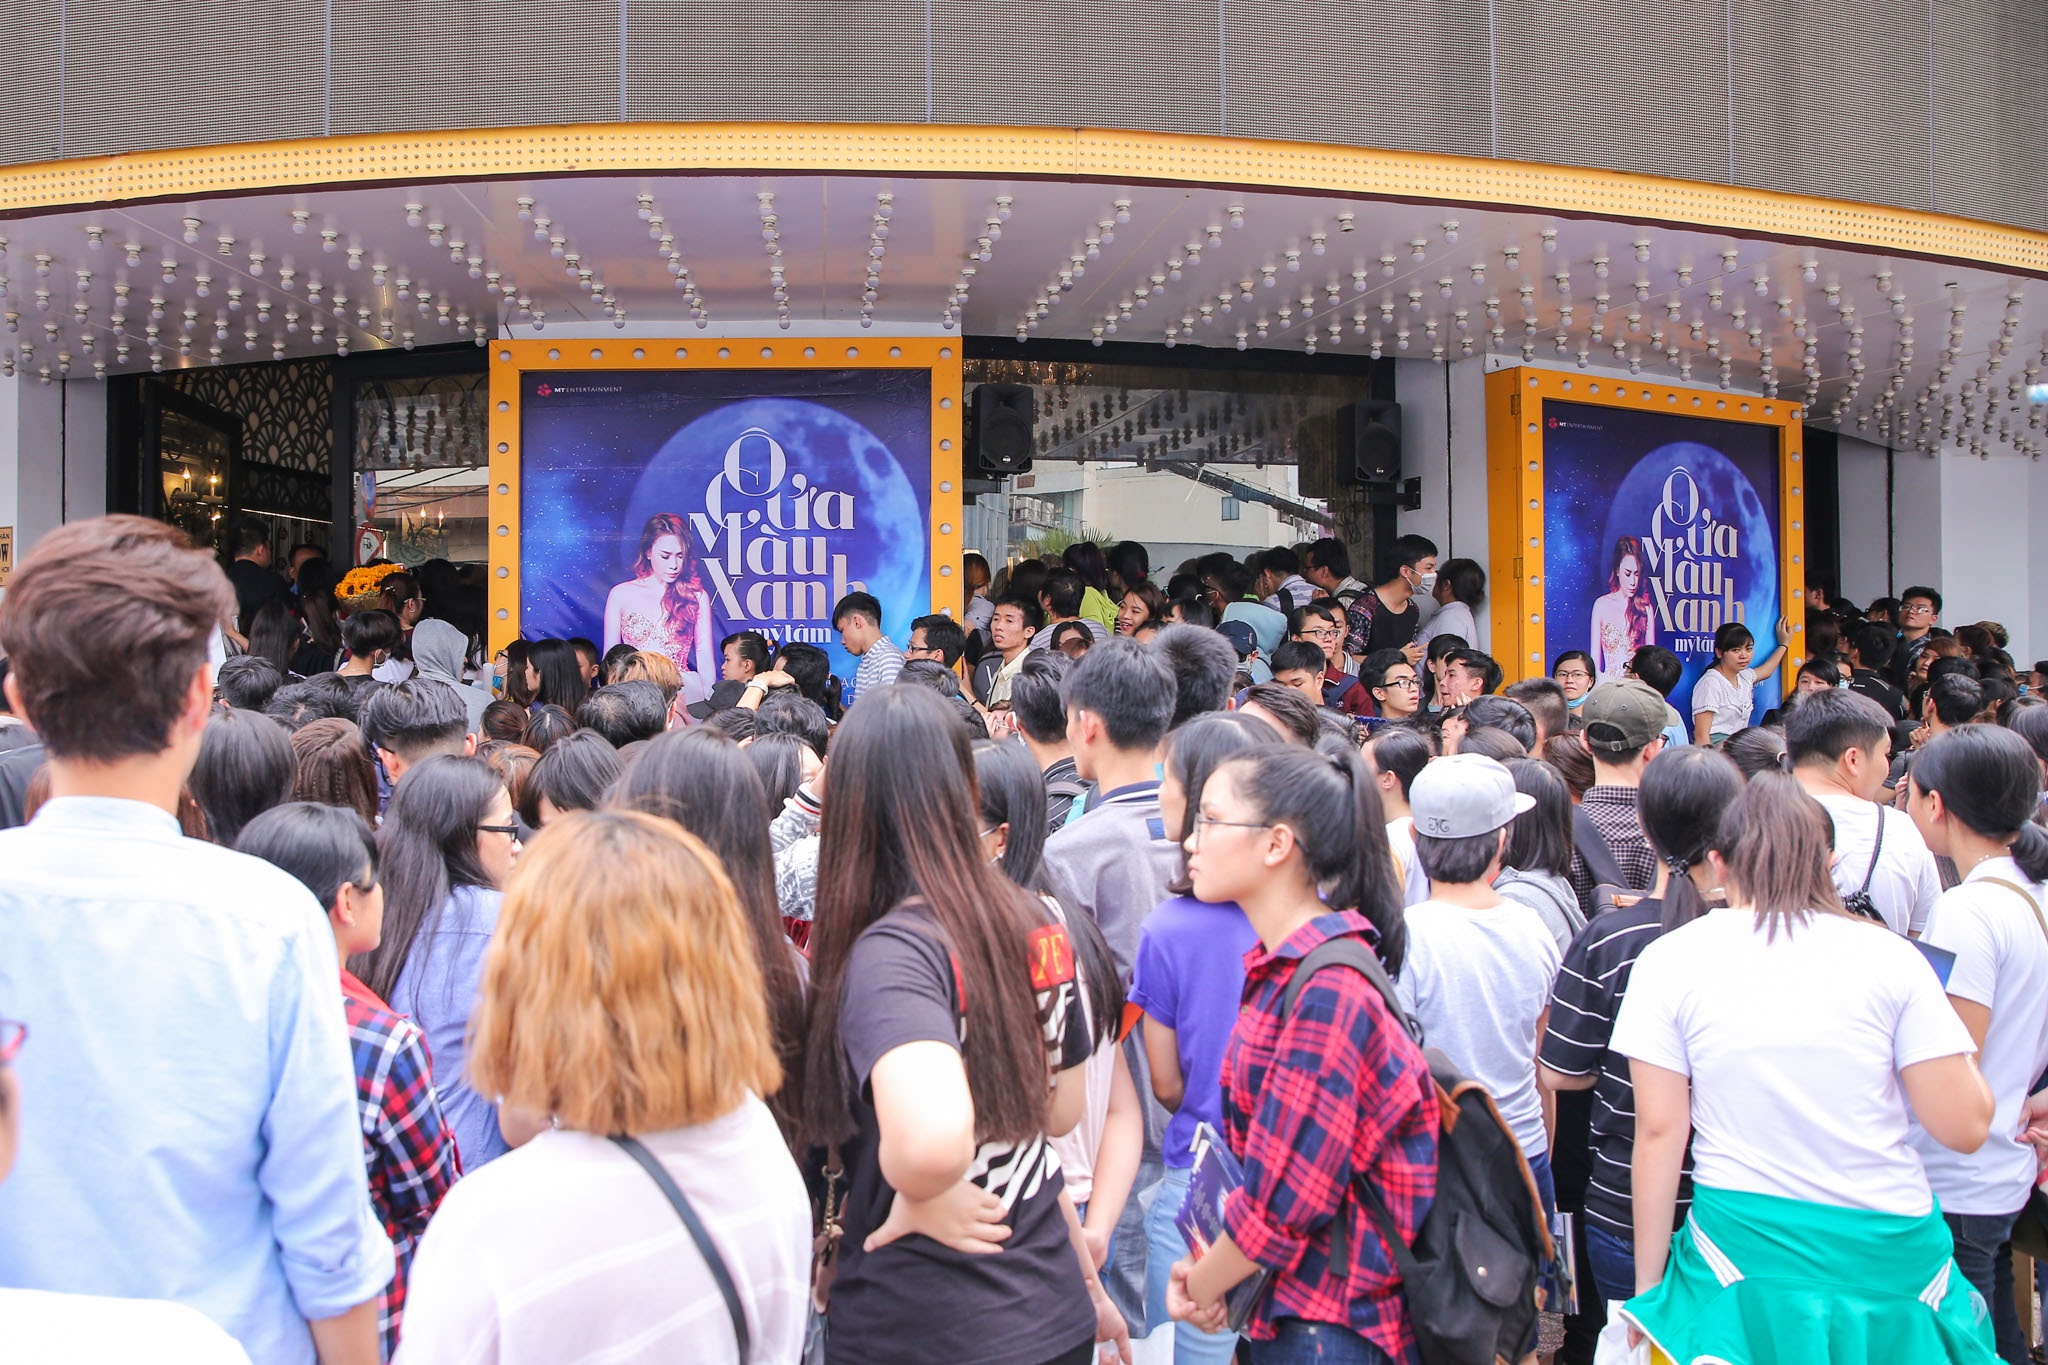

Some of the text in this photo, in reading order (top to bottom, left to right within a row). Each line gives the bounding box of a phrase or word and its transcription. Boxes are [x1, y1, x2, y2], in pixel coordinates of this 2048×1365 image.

[723, 426, 787, 497] Ô
[1662, 465, 1700, 526] Ô
[689, 512, 828, 577] Màu
[1641, 536, 1723, 596] Màu
[1648, 577, 1745, 633] Xanh
